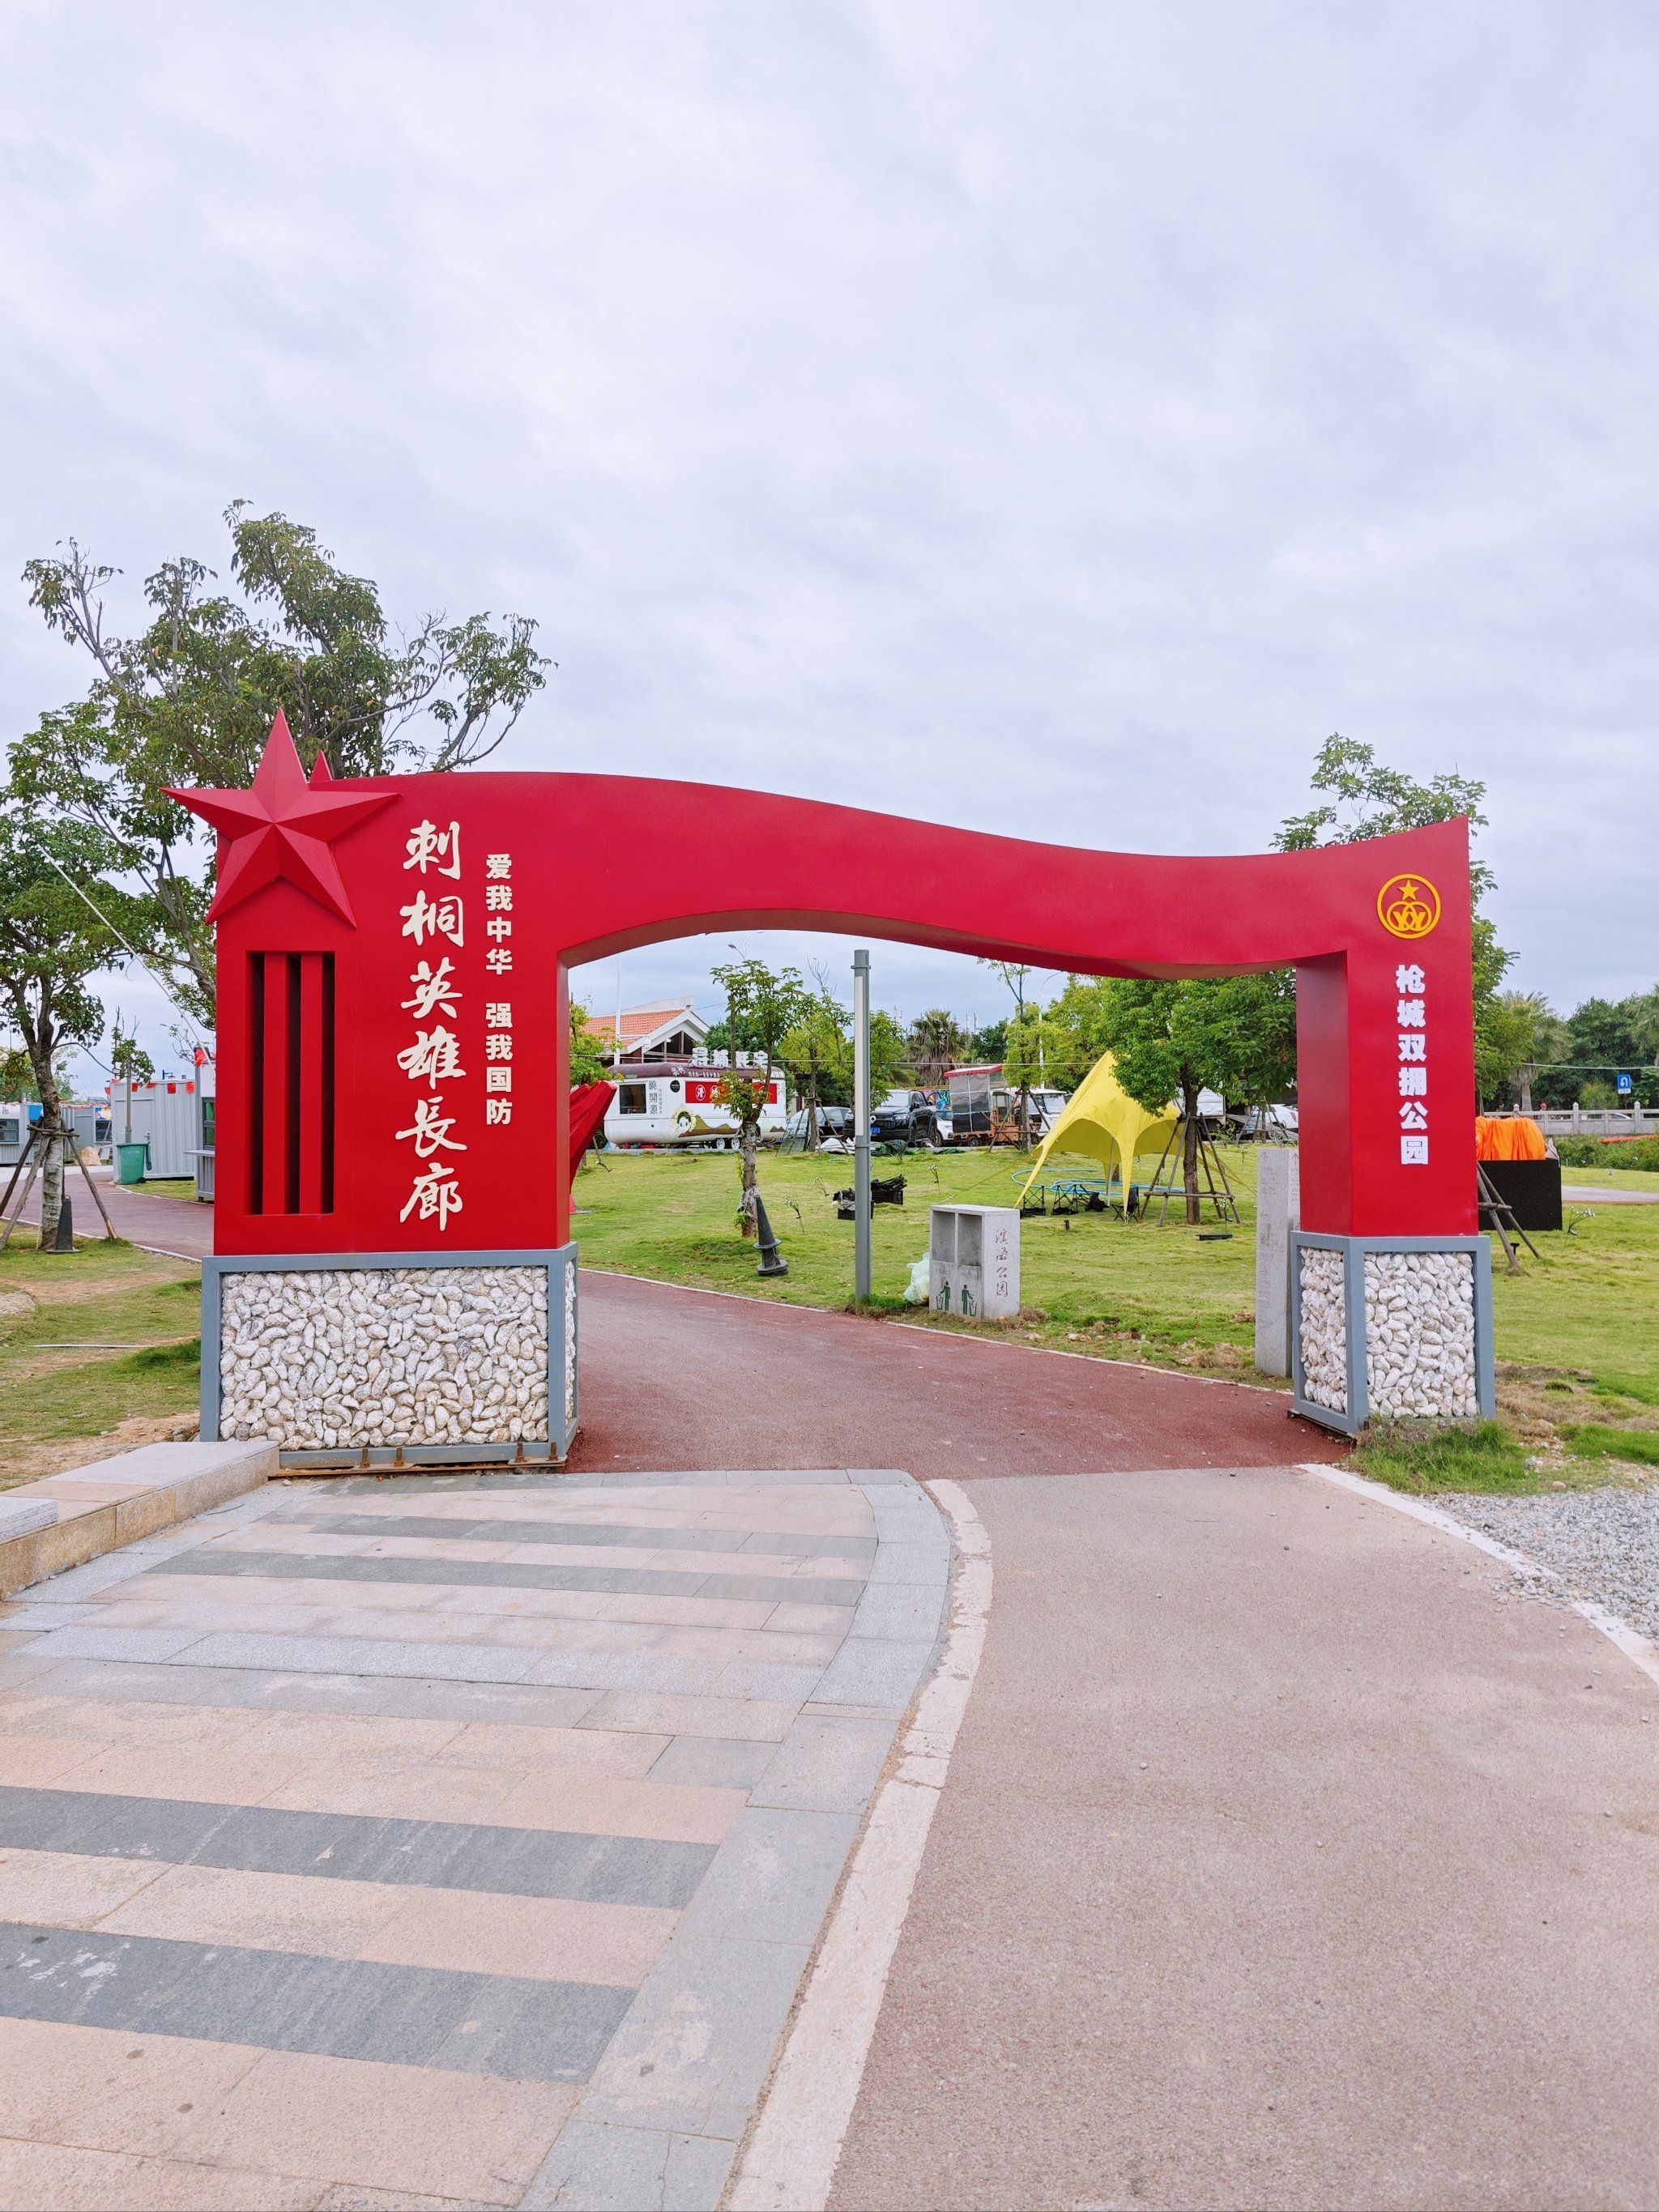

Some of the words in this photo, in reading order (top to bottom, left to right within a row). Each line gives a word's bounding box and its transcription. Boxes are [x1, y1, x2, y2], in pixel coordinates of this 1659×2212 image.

[485, 853, 514, 975] 爱我中华
[395, 819, 467, 1231] 刺桐英雄長廊
[485, 1003, 514, 1126] 强我国防
[1395, 964, 1429, 1166] 枪城双拥公园
